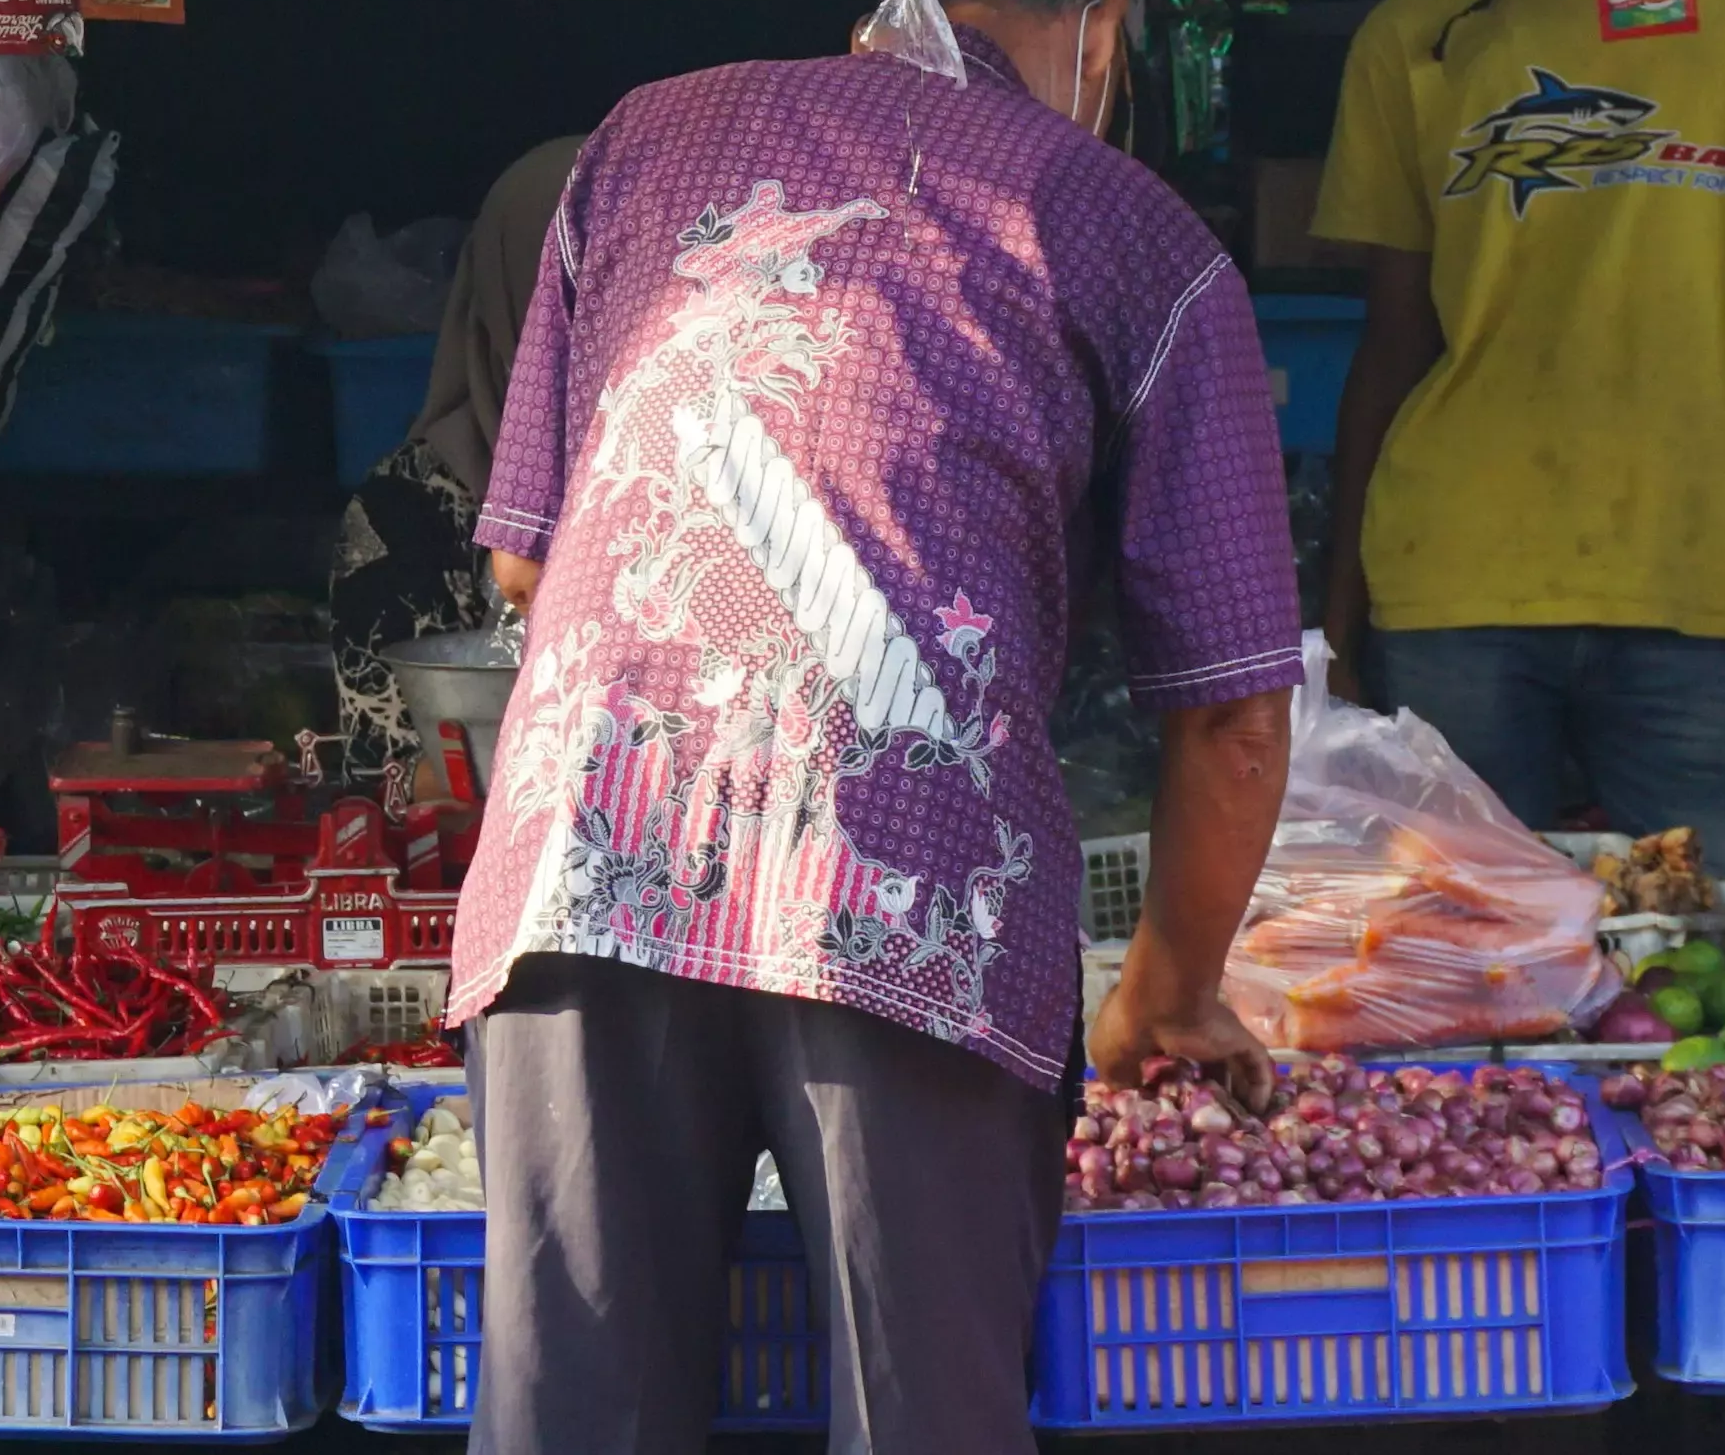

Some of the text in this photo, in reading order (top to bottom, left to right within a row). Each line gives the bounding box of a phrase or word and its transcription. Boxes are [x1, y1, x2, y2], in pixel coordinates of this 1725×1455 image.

[1592, 167, 1687, 189] RESPECT
[319, 891, 385, 912] LIBRA
[332, 919, 375, 931] LIBRA
